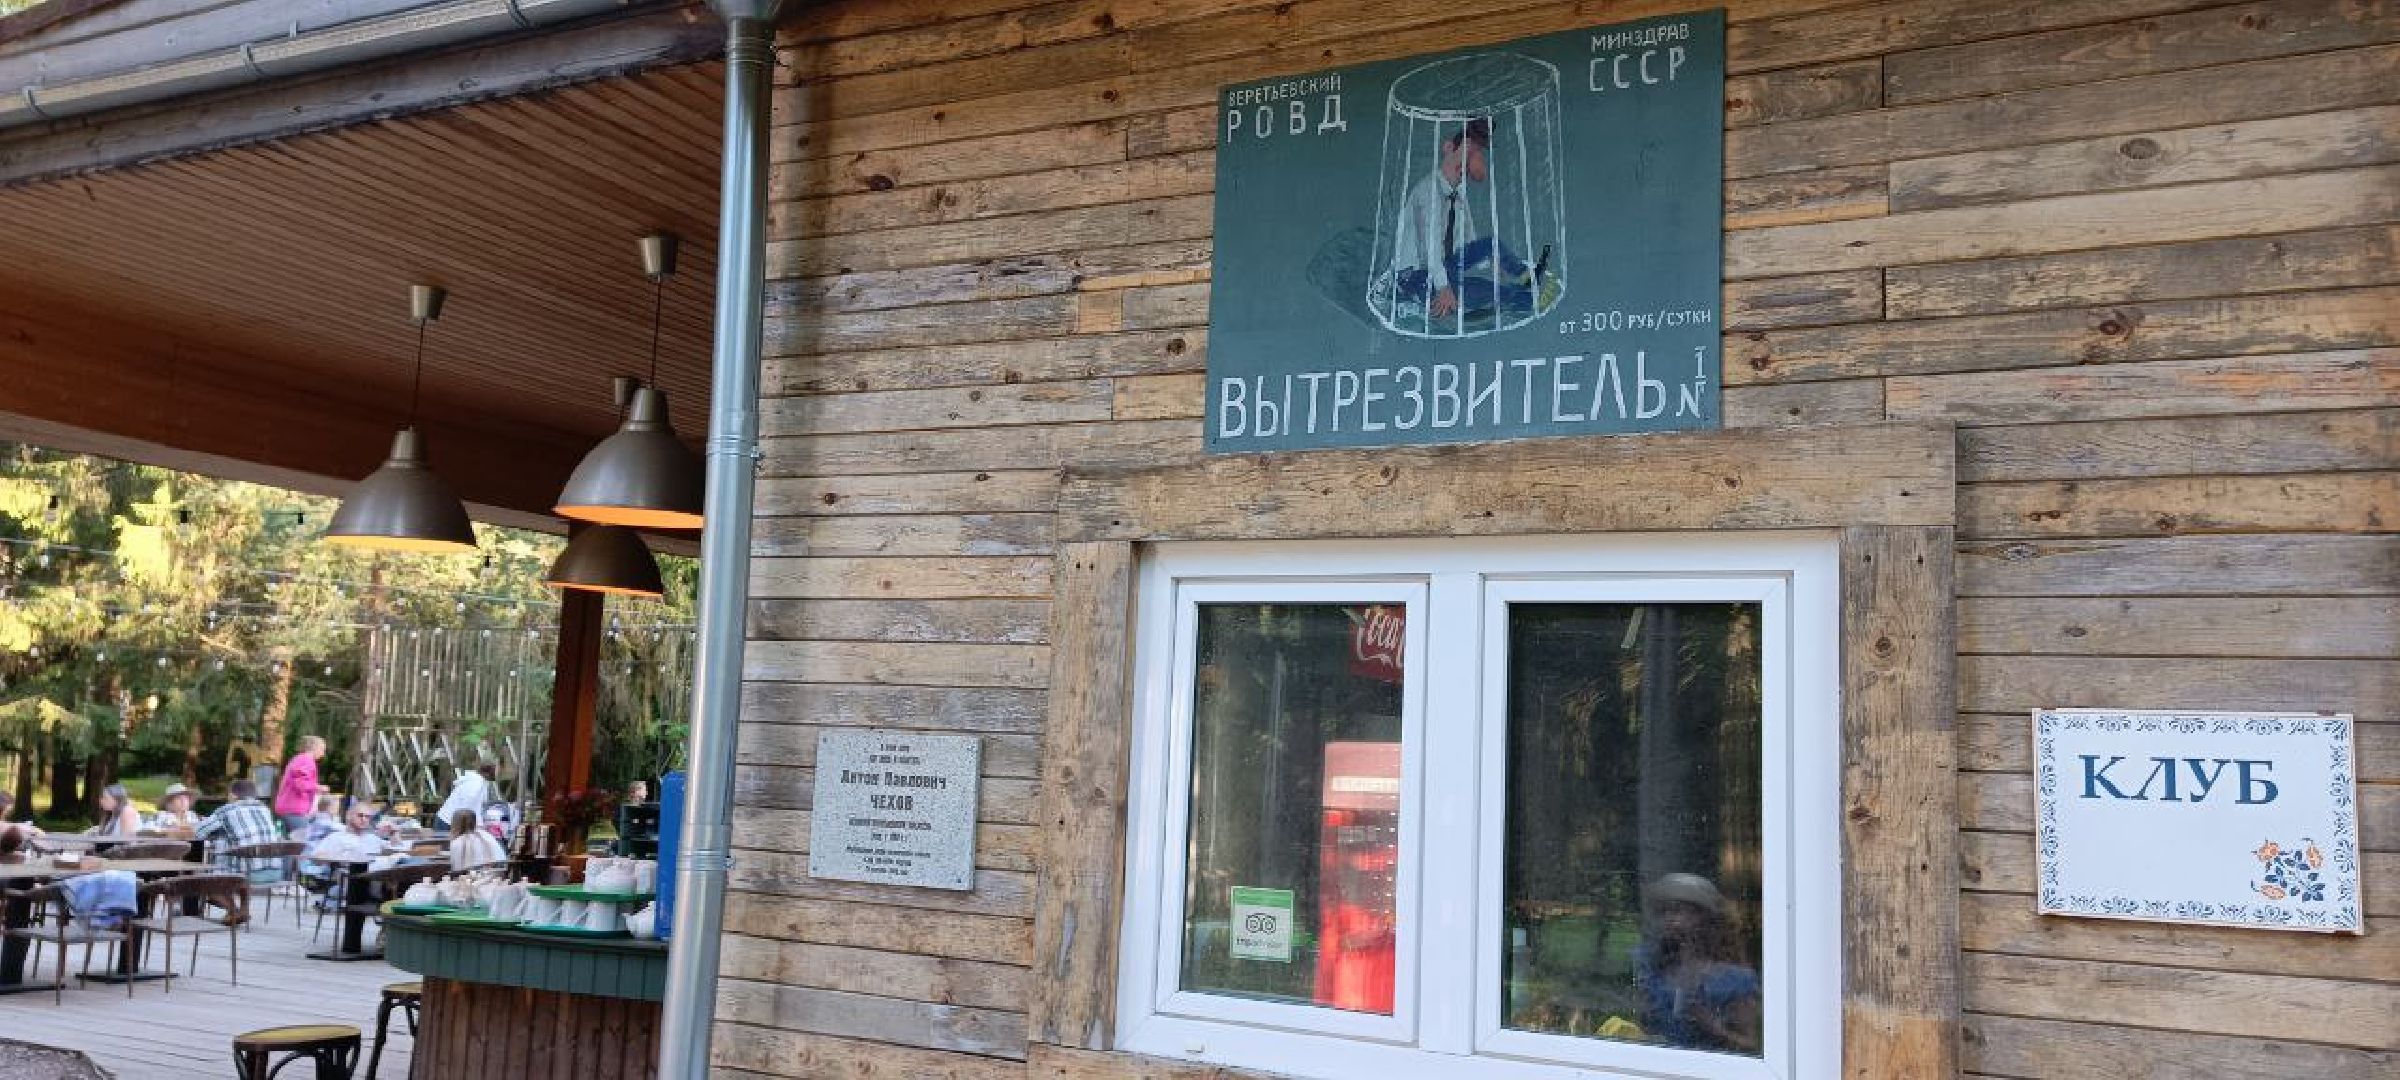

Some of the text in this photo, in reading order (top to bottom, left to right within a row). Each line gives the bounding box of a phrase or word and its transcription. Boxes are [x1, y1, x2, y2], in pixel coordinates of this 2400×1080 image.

[1591, 23, 1689, 53] МИНЗДРАВ
[1589, 46, 1686, 92] СССР
[1229, 72, 1341, 107] ВЕРЕТЬЕВСКИЙ
[1226, 94, 1347, 143] РОВД
[1581, 310, 1622, 332] 300
[1218, 351, 1667, 439] ВЫТРЕЗВИТЕЛЬ
[2078, 754, 2279, 805] КЛУБ
[870, 794, 914, 811] ЧЕХОВ
